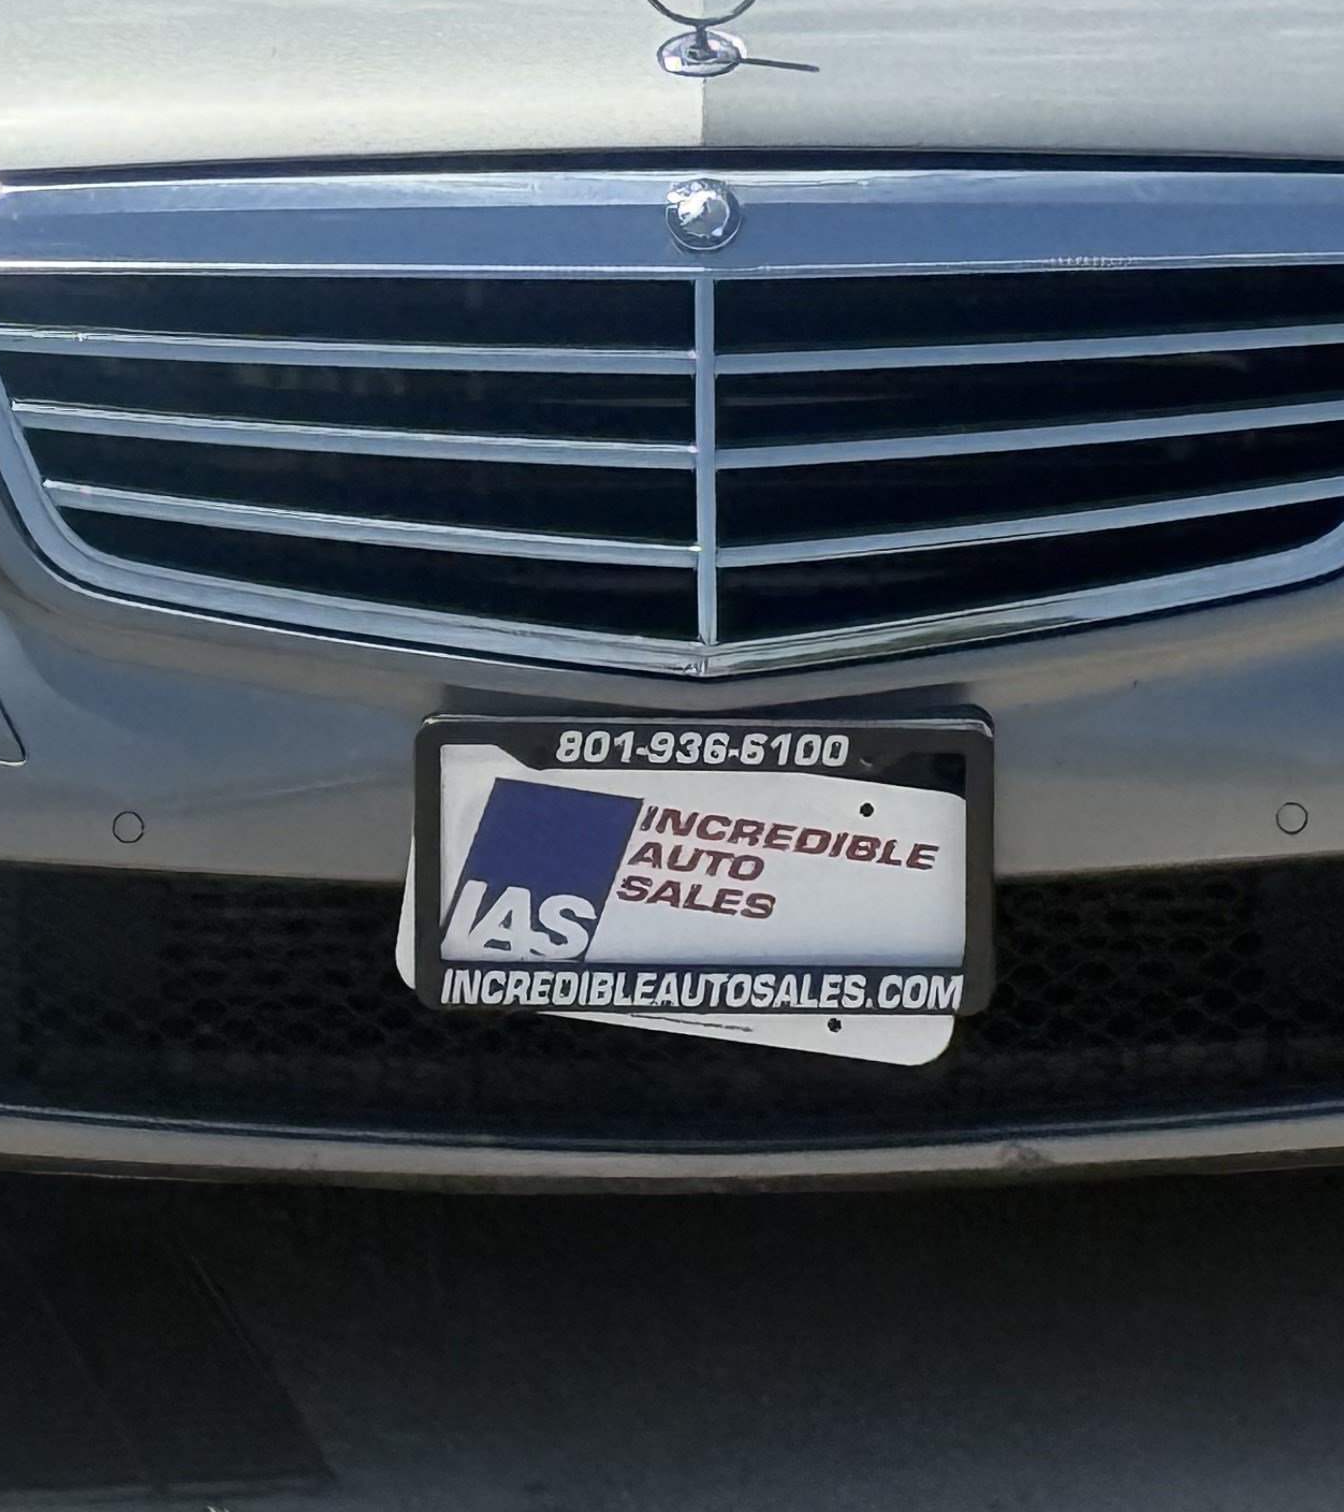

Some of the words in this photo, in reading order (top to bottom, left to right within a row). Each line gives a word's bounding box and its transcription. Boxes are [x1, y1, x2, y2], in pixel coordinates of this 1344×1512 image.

[627, 841, 766, 882] AUTO
[640, 805, 940, 871] INCREDIBLE
[447, 879, 598, 960] IAS
[615, 874, 777, 921] SALES
[440, 966, 965, 1012] INCREDIBLEAUTOSALES.COM
